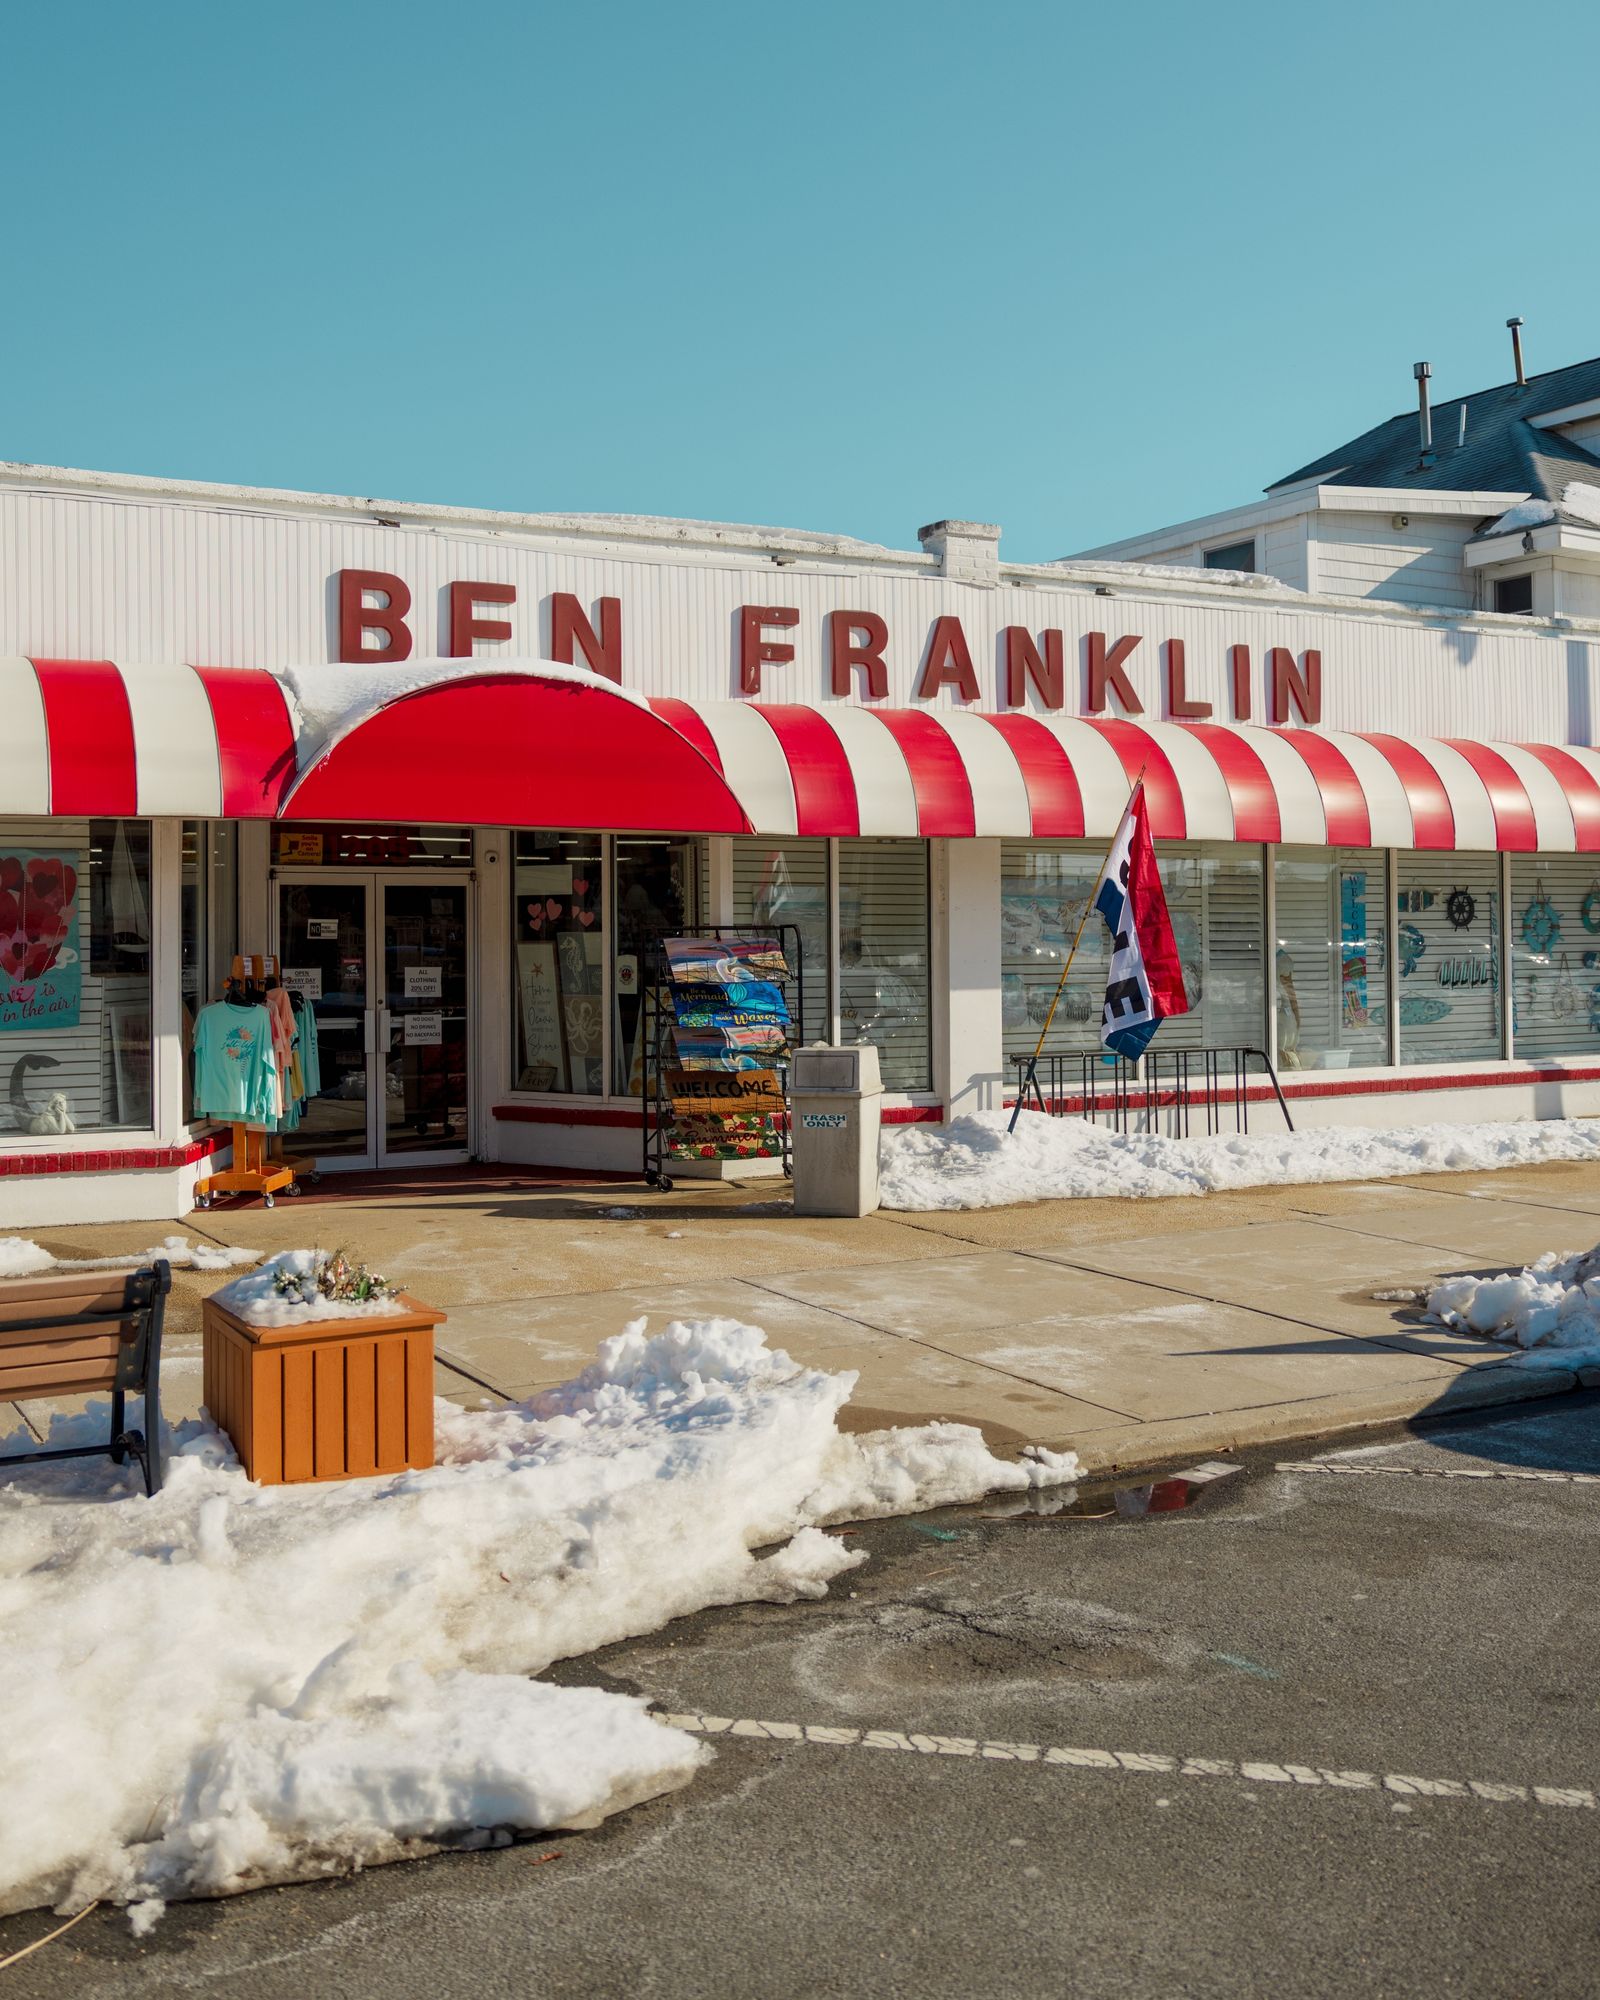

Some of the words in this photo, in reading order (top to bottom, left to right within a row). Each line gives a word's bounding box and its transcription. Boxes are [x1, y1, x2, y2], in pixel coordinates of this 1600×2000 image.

[339, 568, 621, 685] BEN
[741, 605, 1321, 724] FRANKLIN
[1349, 876, 1360, 955] WELCOME
[41, 983, 55, 996] is
[675, 991, 729, 1003] Mermaid
[4, 1009, 17, 1022] in
[22, 1000, 45, 1019] the
[49, 994, 77, 1012] air!
[672, 1080, 772, 1098] WELCOME
